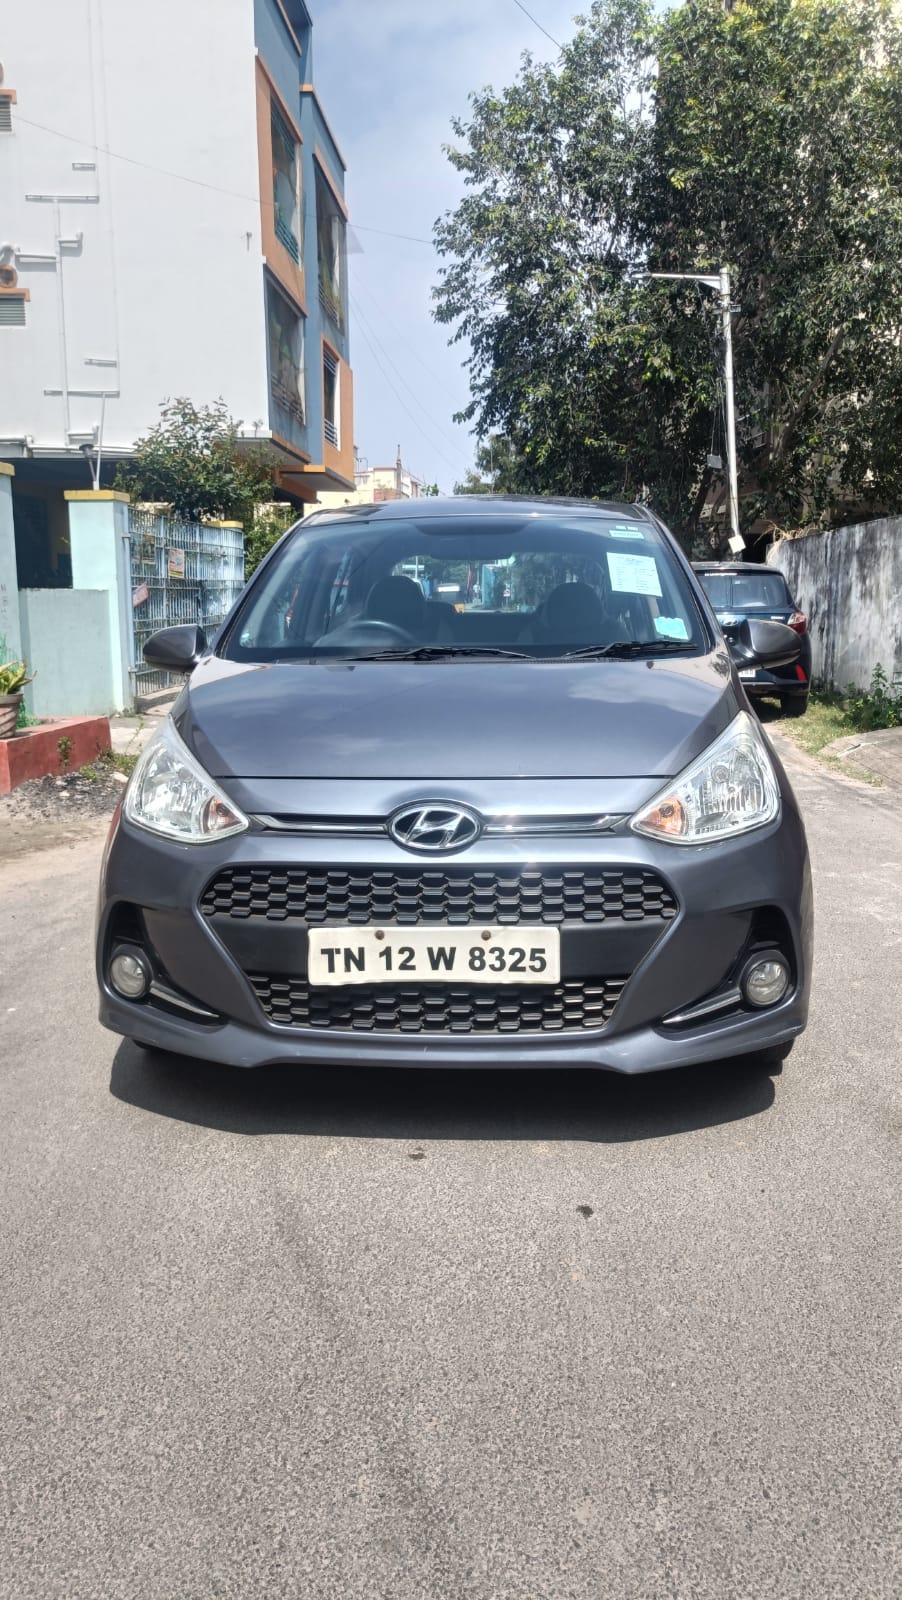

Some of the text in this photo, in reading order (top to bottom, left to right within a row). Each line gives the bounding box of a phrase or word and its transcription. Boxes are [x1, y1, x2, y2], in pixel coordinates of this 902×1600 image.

[320, 946, 547, 973] TN 12 W 8325
